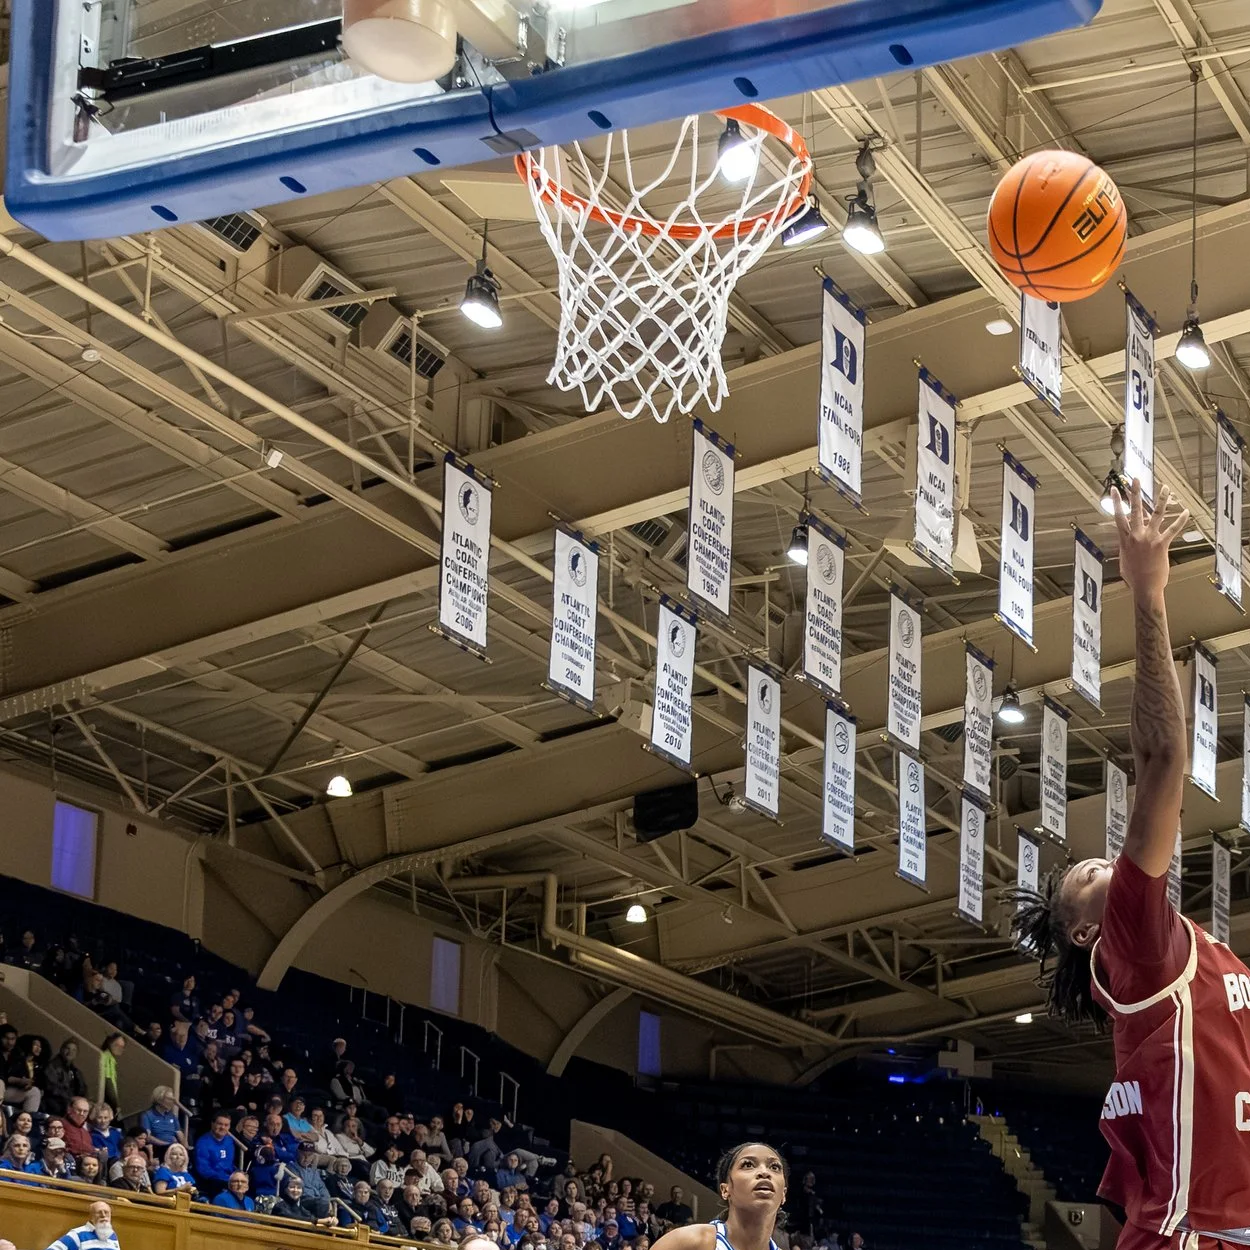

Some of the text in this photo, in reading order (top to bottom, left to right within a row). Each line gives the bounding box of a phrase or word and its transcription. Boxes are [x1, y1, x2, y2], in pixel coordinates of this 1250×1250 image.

[834, 391, 853, 417] NCAA
[1131, 368, 1150, 425] 32
[822, 404, 842, 433] FINAL
[833, 451, 851, 475] 1988
[928, 471, 946, 495] NCAA
[699, 497, 726, 527] ATLANTIC
[1223, 483, 1236, 527] 11
[702, 515, 722, 539] COAST
[451, 530, 483, 560] ATLANTIC
[692, 523, 731, 561] CONFERENCE
[455, 549, 479, 570] COAST
[693, 539, 729, 574] CHAMPIONS
[1011, 548, 1026, 570] NCAA
[444, 556, 489, 593] CONFERENCE
[1003, 561, 1018, 584] FINAL
[446, 572, 487, 607] CHAMPIONS
[702, 578, 719, 599] 1964
[812, 587, 837, 613] ATLANTIC
[560, 592, 591, 618] ATLANTIC
[817, 602, 834, 621] COAST
[455, 611, 474, 632] 2006
[566, 609, 587, 629] COAST
[807, 611, 842, 643] CONFERENCE
[554, 617, 594, 651] CONFERENCE
[554, 632, 593, 663] CHAMPIONS
[565, 667, 582, 687] 2009
[817, 659, 833, 679] 1965
[664, 733, 682, 750] 2010
[757, 786, 772, 803] 2011
[832, 822, 846, 838] 2017
